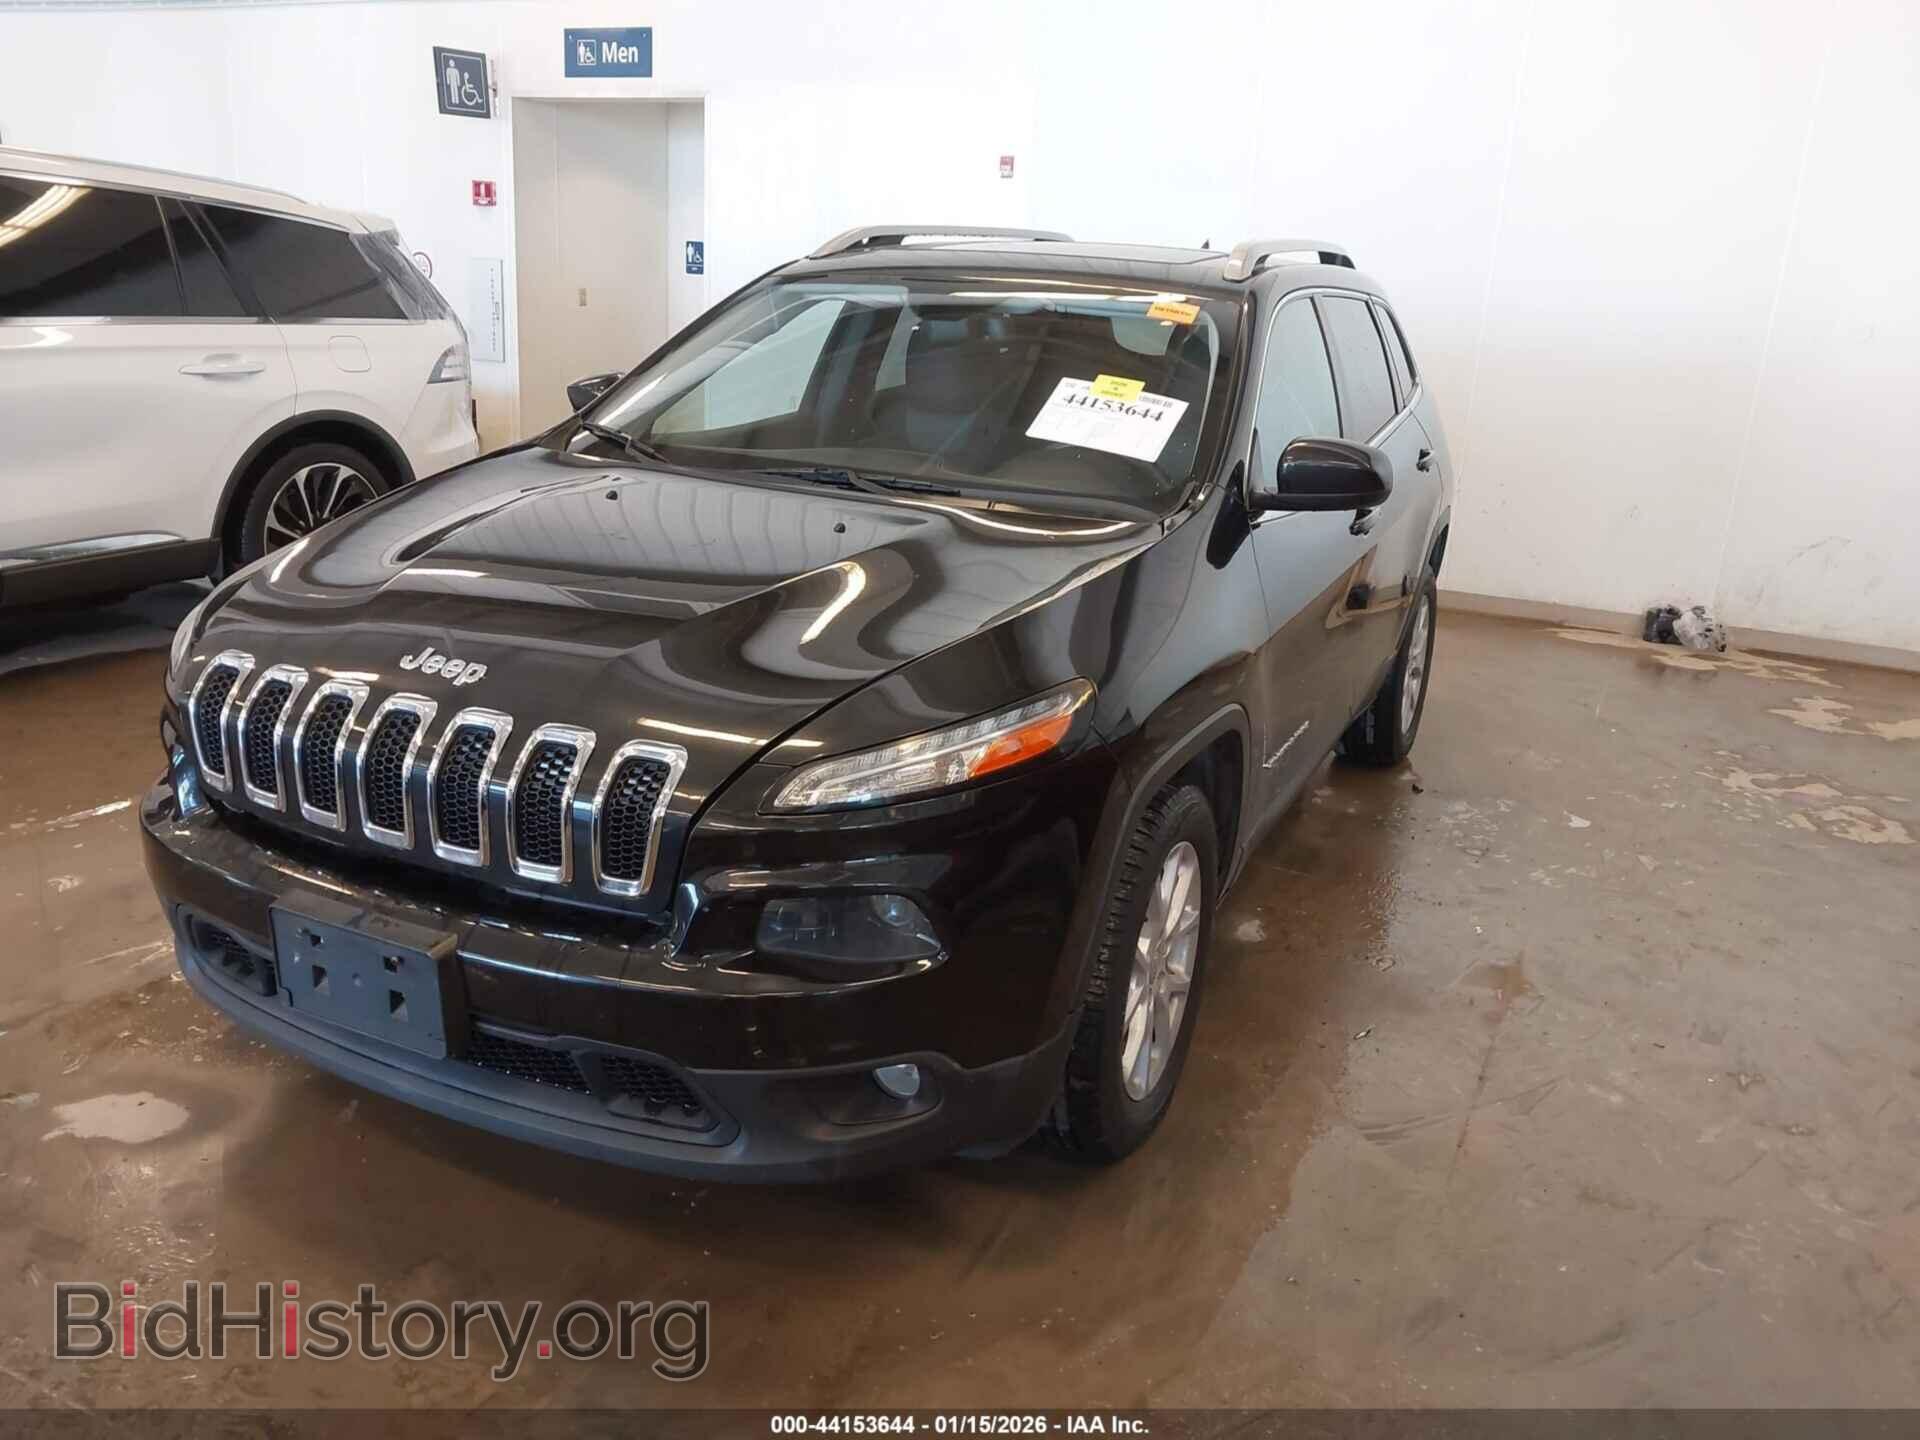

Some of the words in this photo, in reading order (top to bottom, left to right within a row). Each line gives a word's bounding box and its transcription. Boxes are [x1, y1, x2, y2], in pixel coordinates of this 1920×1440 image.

[601, 41, 639, 64] Men
[1062, 393, 1164, 421] 44153644
[399, 646, 488, 687] Jeep
